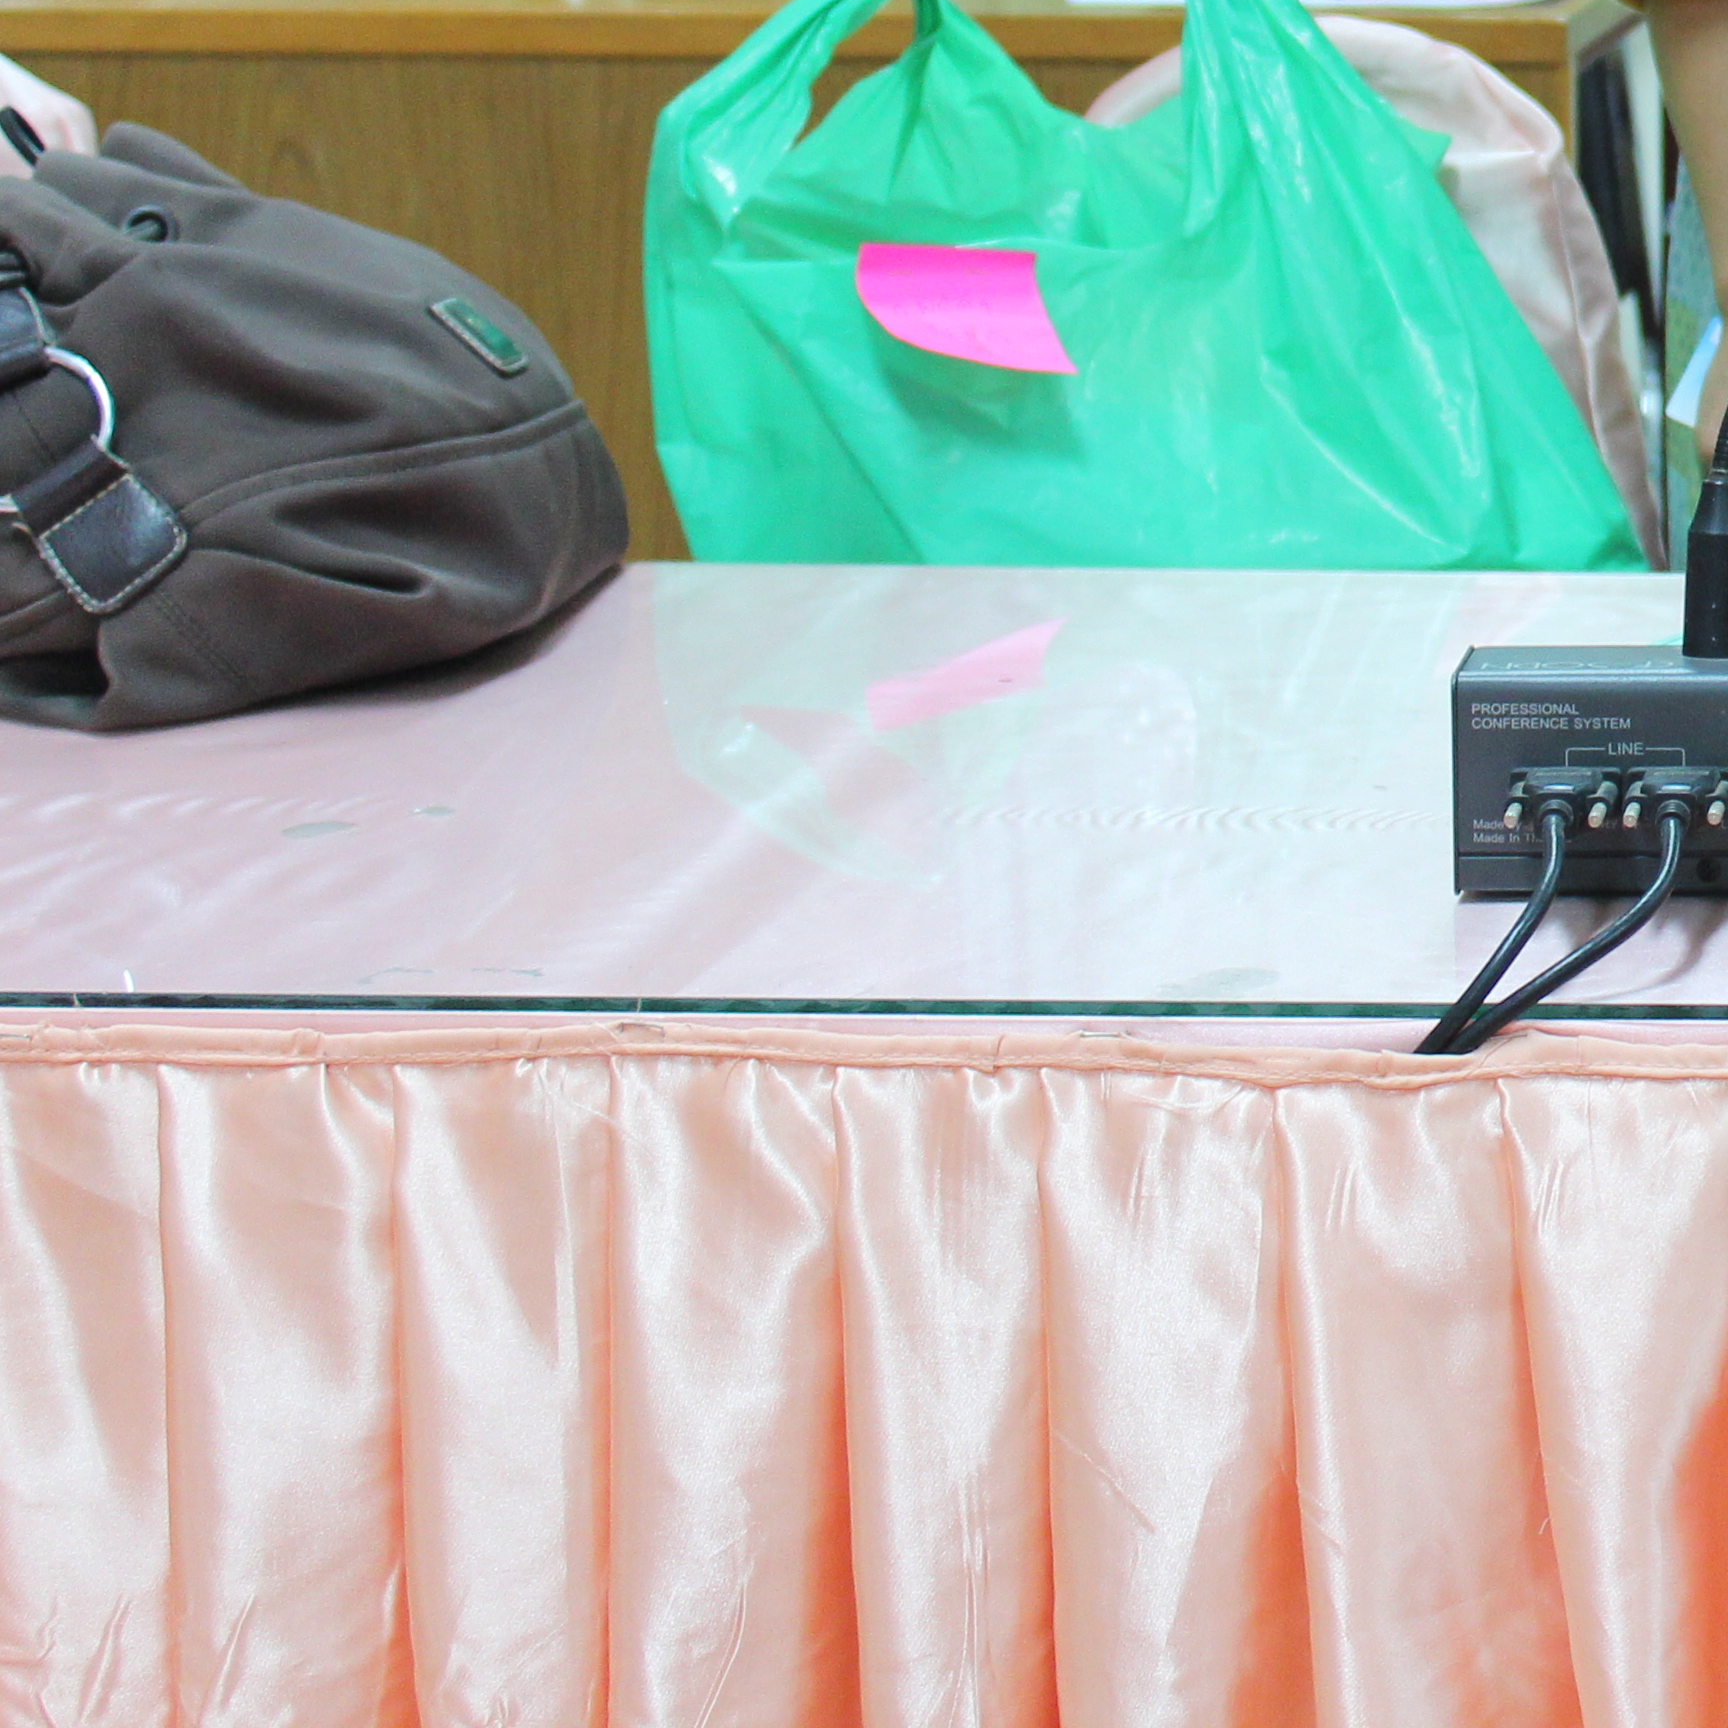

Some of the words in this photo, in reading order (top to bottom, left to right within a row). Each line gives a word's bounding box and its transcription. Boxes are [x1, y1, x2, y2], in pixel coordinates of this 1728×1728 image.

[1471, 703, 1580, 716] PROFESSIONAL
[1471, 718, 1569, 731] CONFERENCE
[1573, 717, 1631, 730] SYSTEM
[1608, 742, 1645, 756] LINE
[1473, 833, 1505, 843] Made
